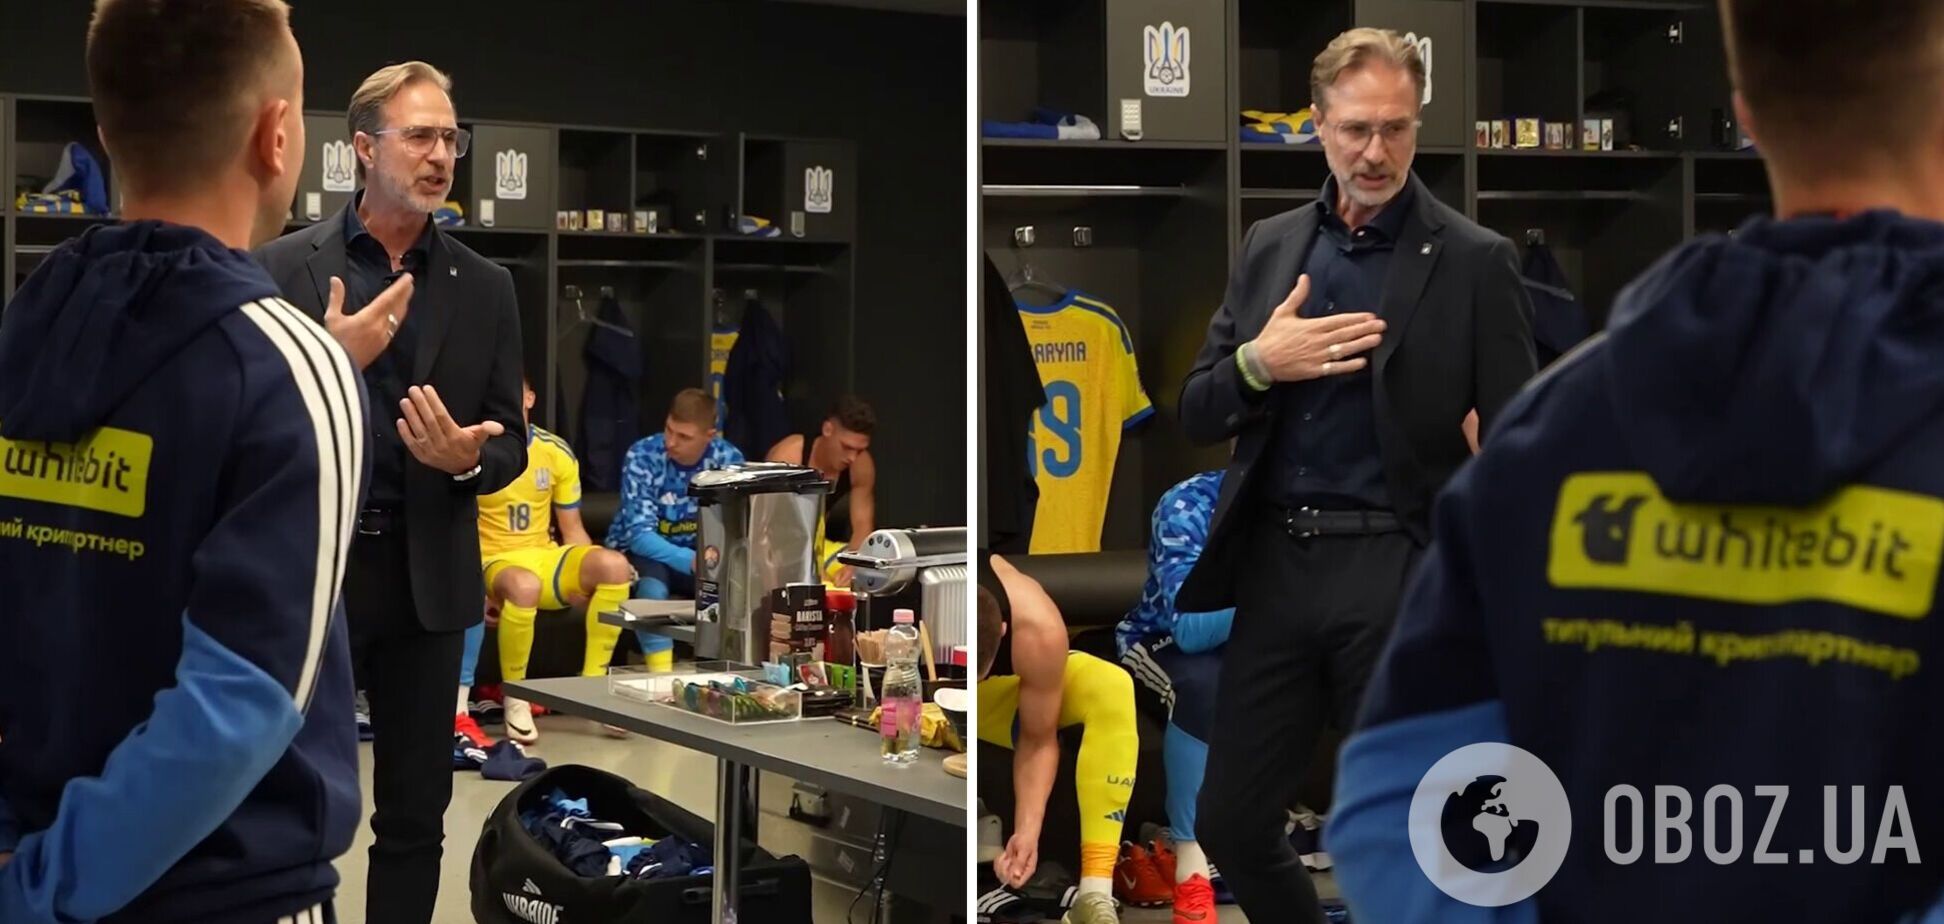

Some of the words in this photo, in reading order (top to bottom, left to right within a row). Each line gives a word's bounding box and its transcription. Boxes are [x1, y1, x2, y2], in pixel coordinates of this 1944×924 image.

[1031, 341, 1086, 363] ARYNA
[507, 503, 530, 532] 18
[1654, 512, 1912, 581] whitebit
